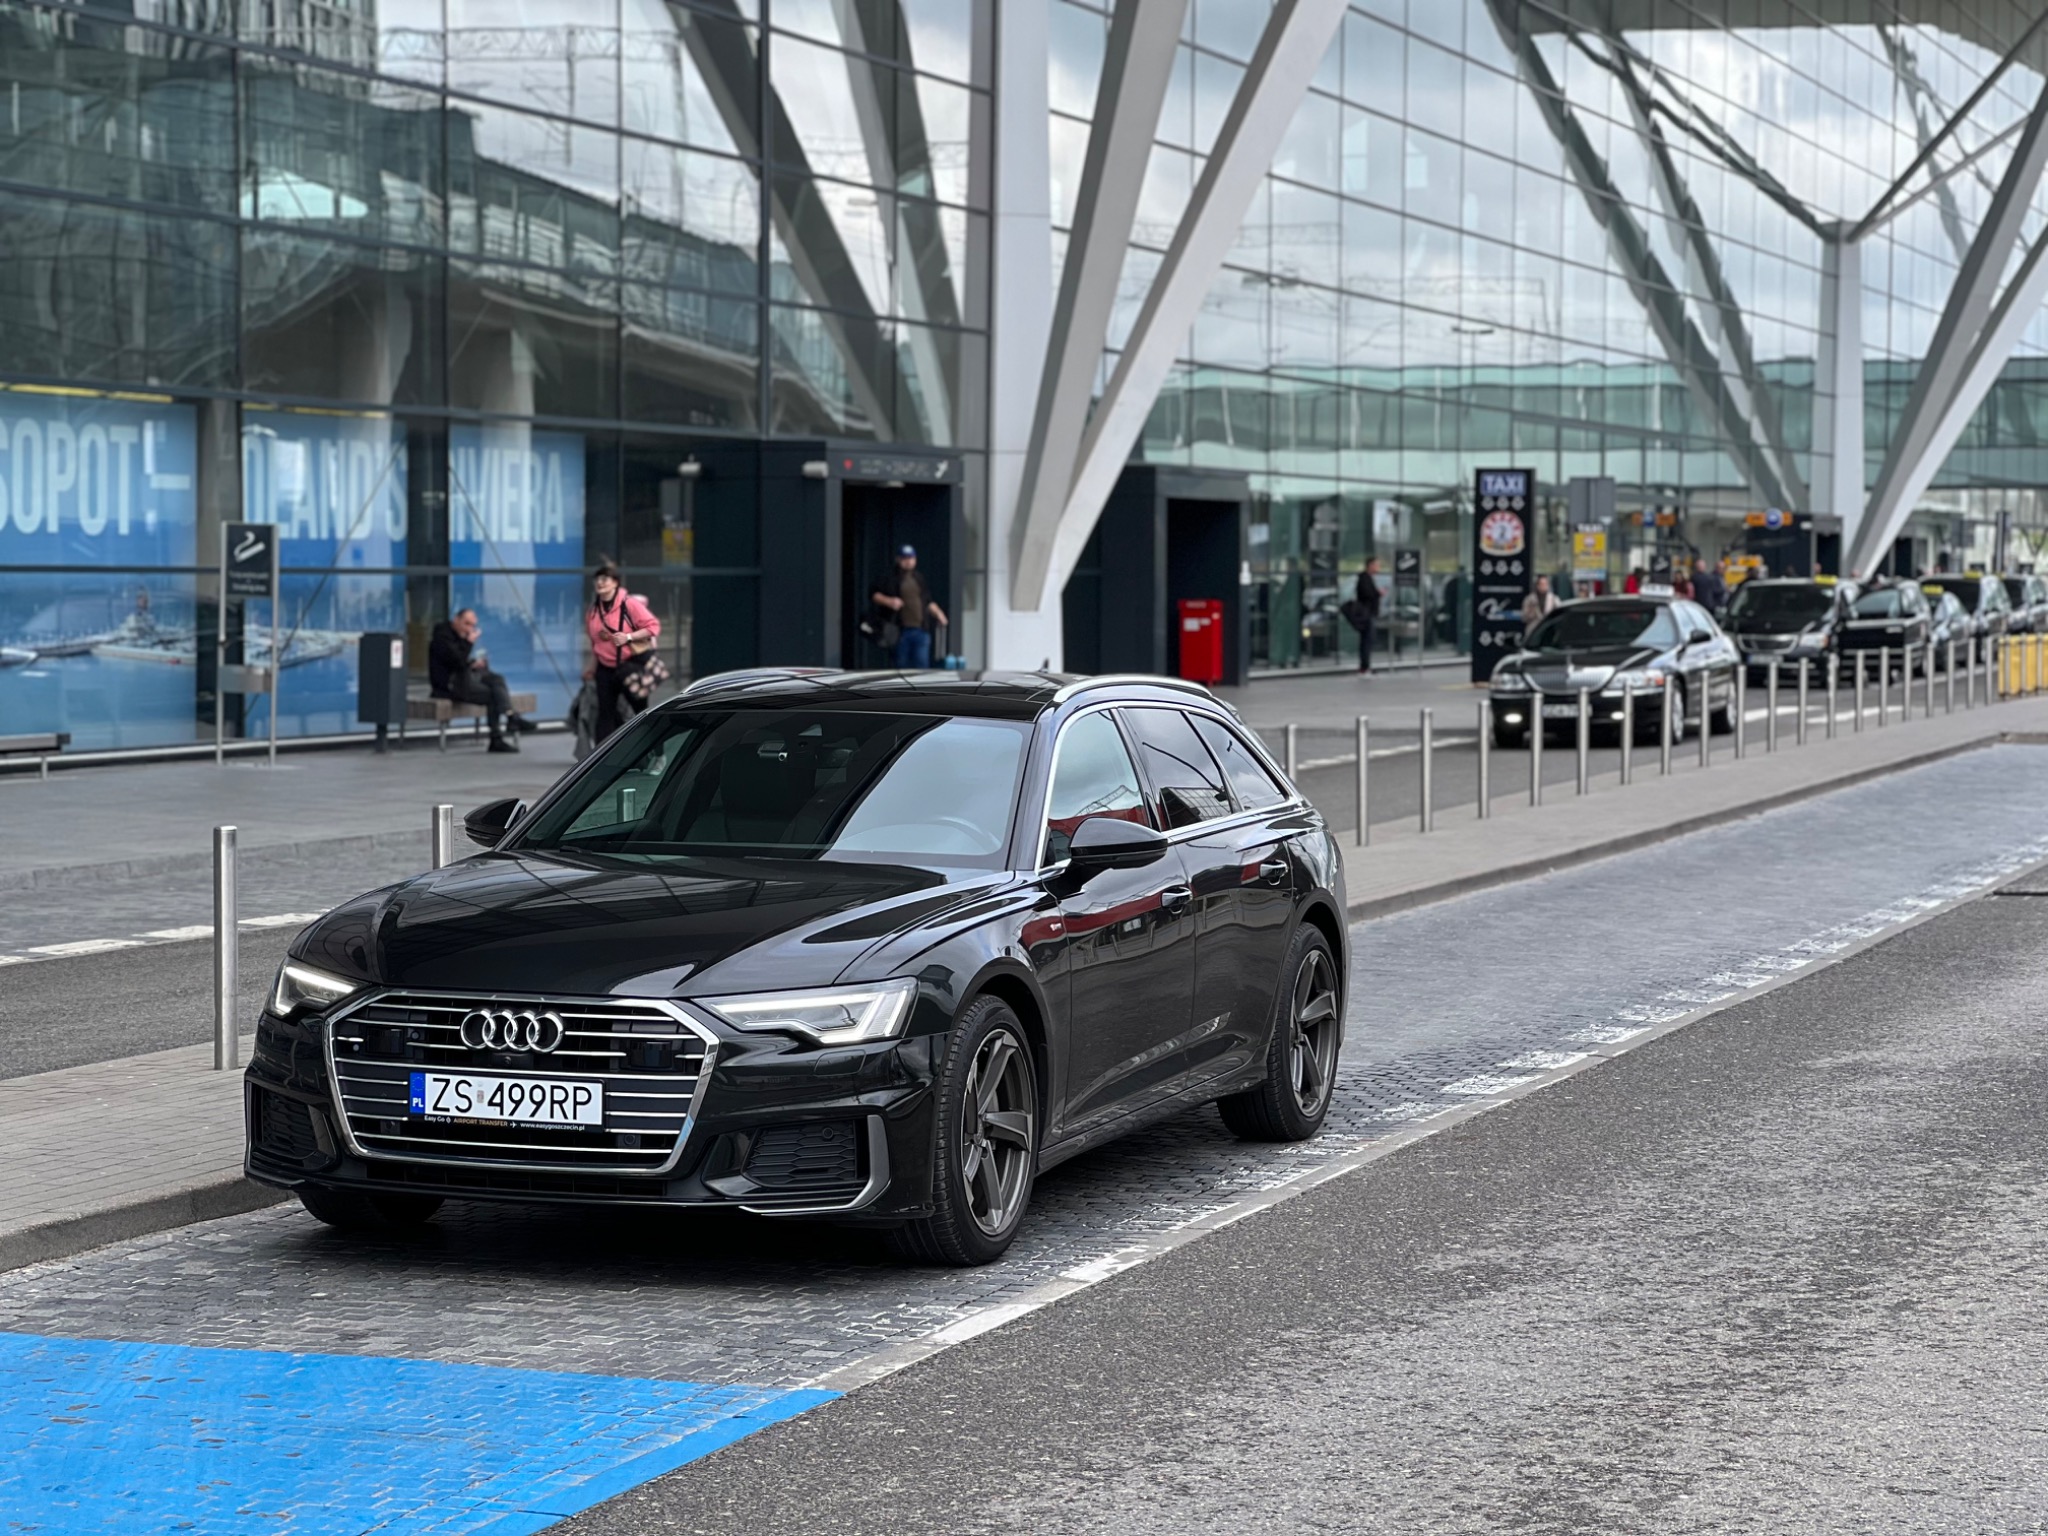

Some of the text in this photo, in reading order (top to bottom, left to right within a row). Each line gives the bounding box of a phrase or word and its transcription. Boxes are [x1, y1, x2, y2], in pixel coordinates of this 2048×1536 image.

[1484, 474, 1525, 491] TAXI
[412, 1098, 423, 1107] PL
[432, 1077, 592, 1120] ZS 499RP
[424, 1115, 436, 1123] Easy
[453, 1117, 478, 1125] AIRPORT
[479, 1118, 508, 1127] TRANSFER
